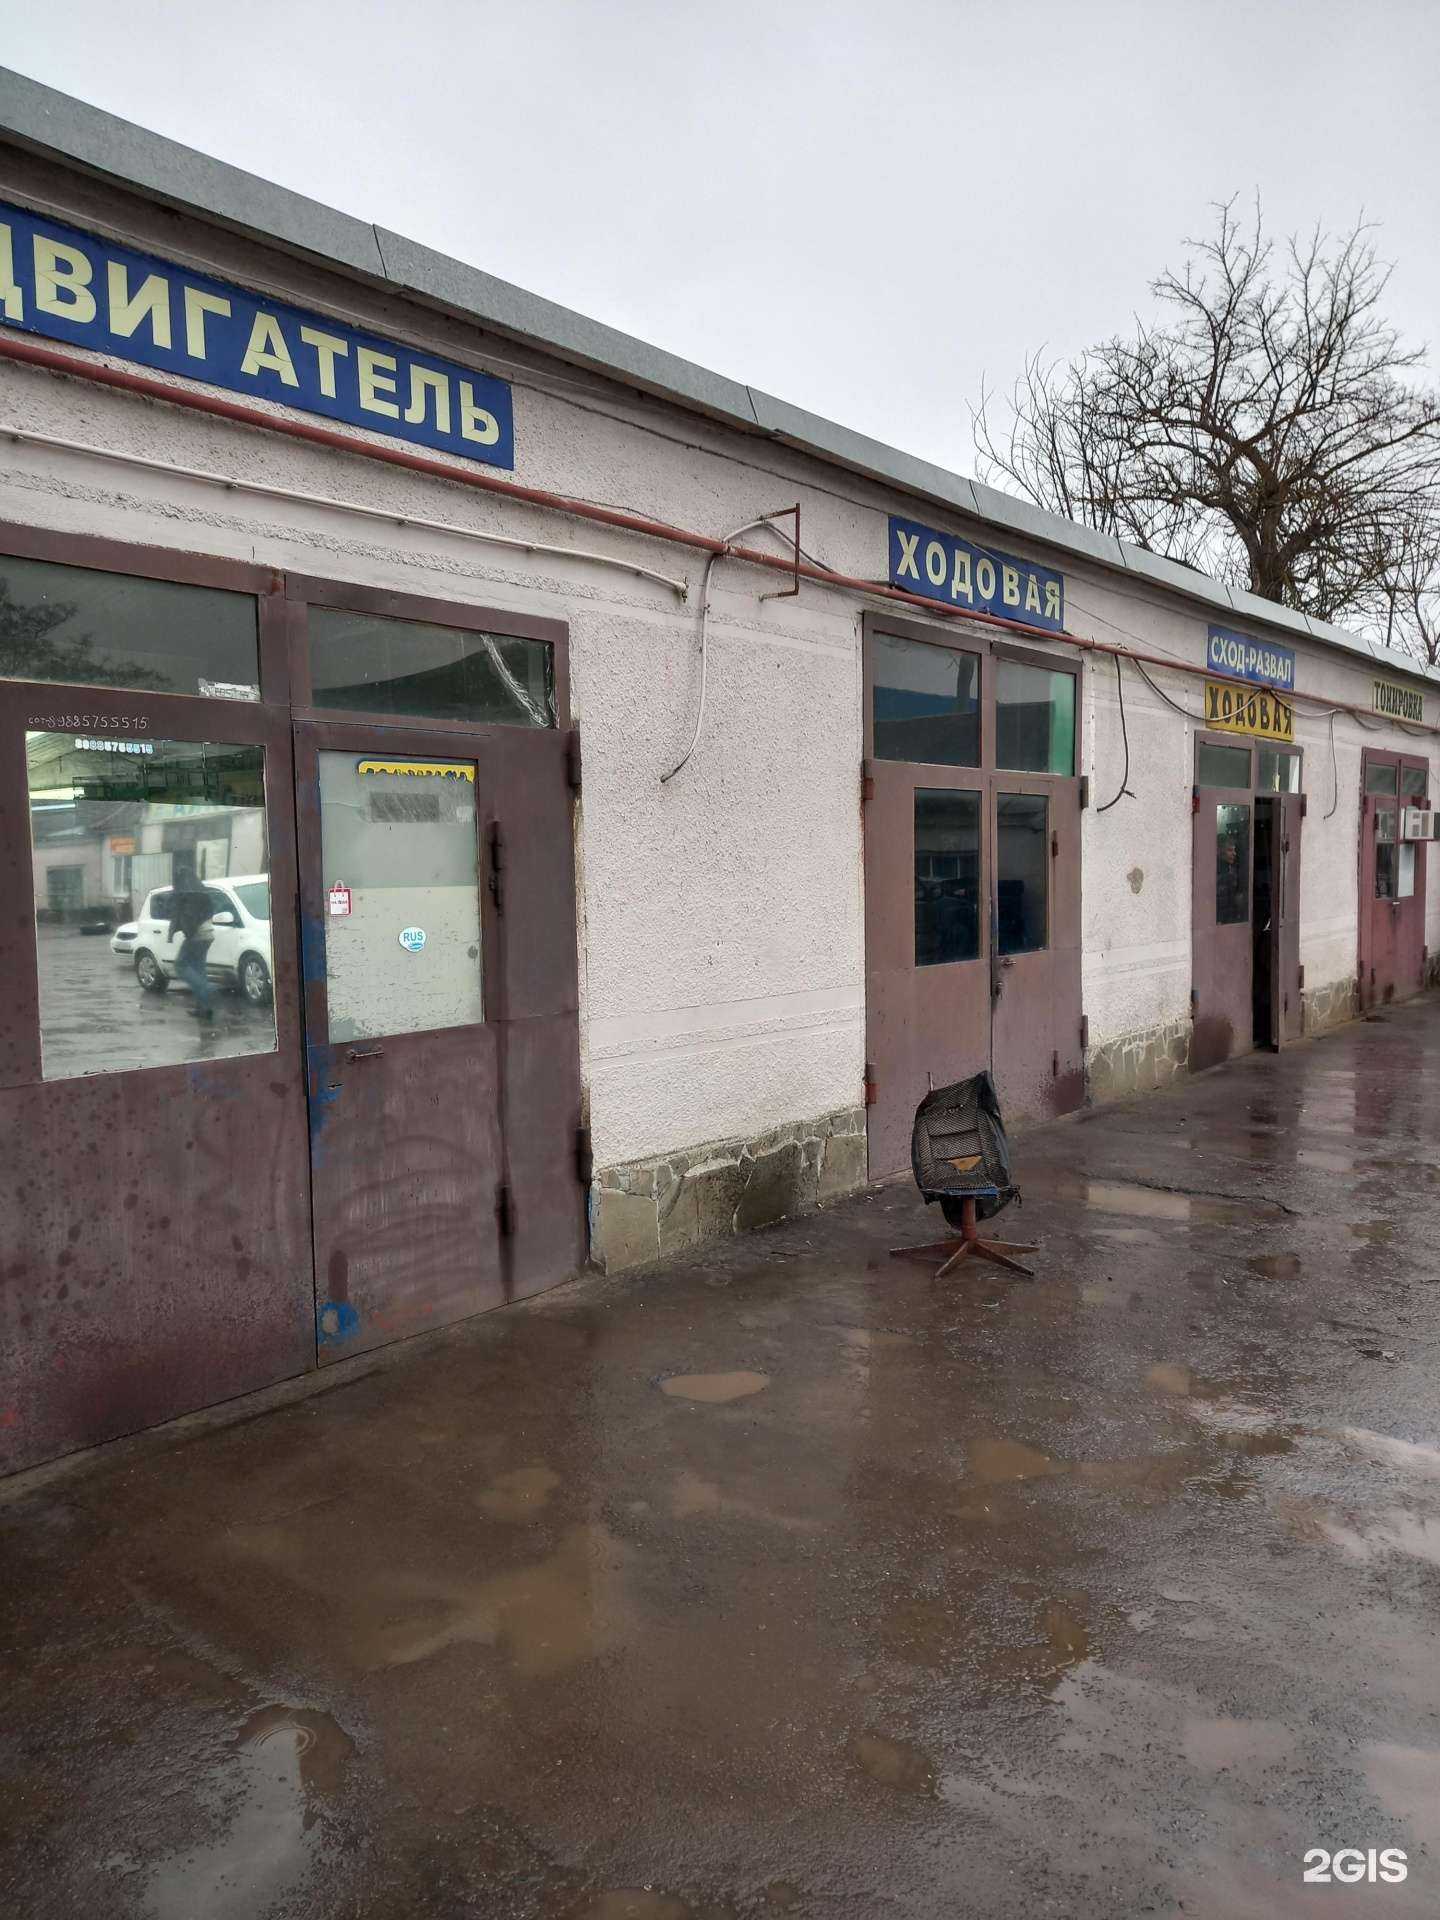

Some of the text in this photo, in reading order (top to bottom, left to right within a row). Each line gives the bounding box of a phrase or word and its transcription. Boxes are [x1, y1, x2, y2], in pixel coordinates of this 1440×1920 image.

[896, 529, 1061, 621] ХОДОВАЯ
[1211, 635, 1292, 682] СХОД-РАЗВАЛ
[1208, 686, 1292, 735] ХОДОВАЯ
[403, 931, 424, 943] RUS
